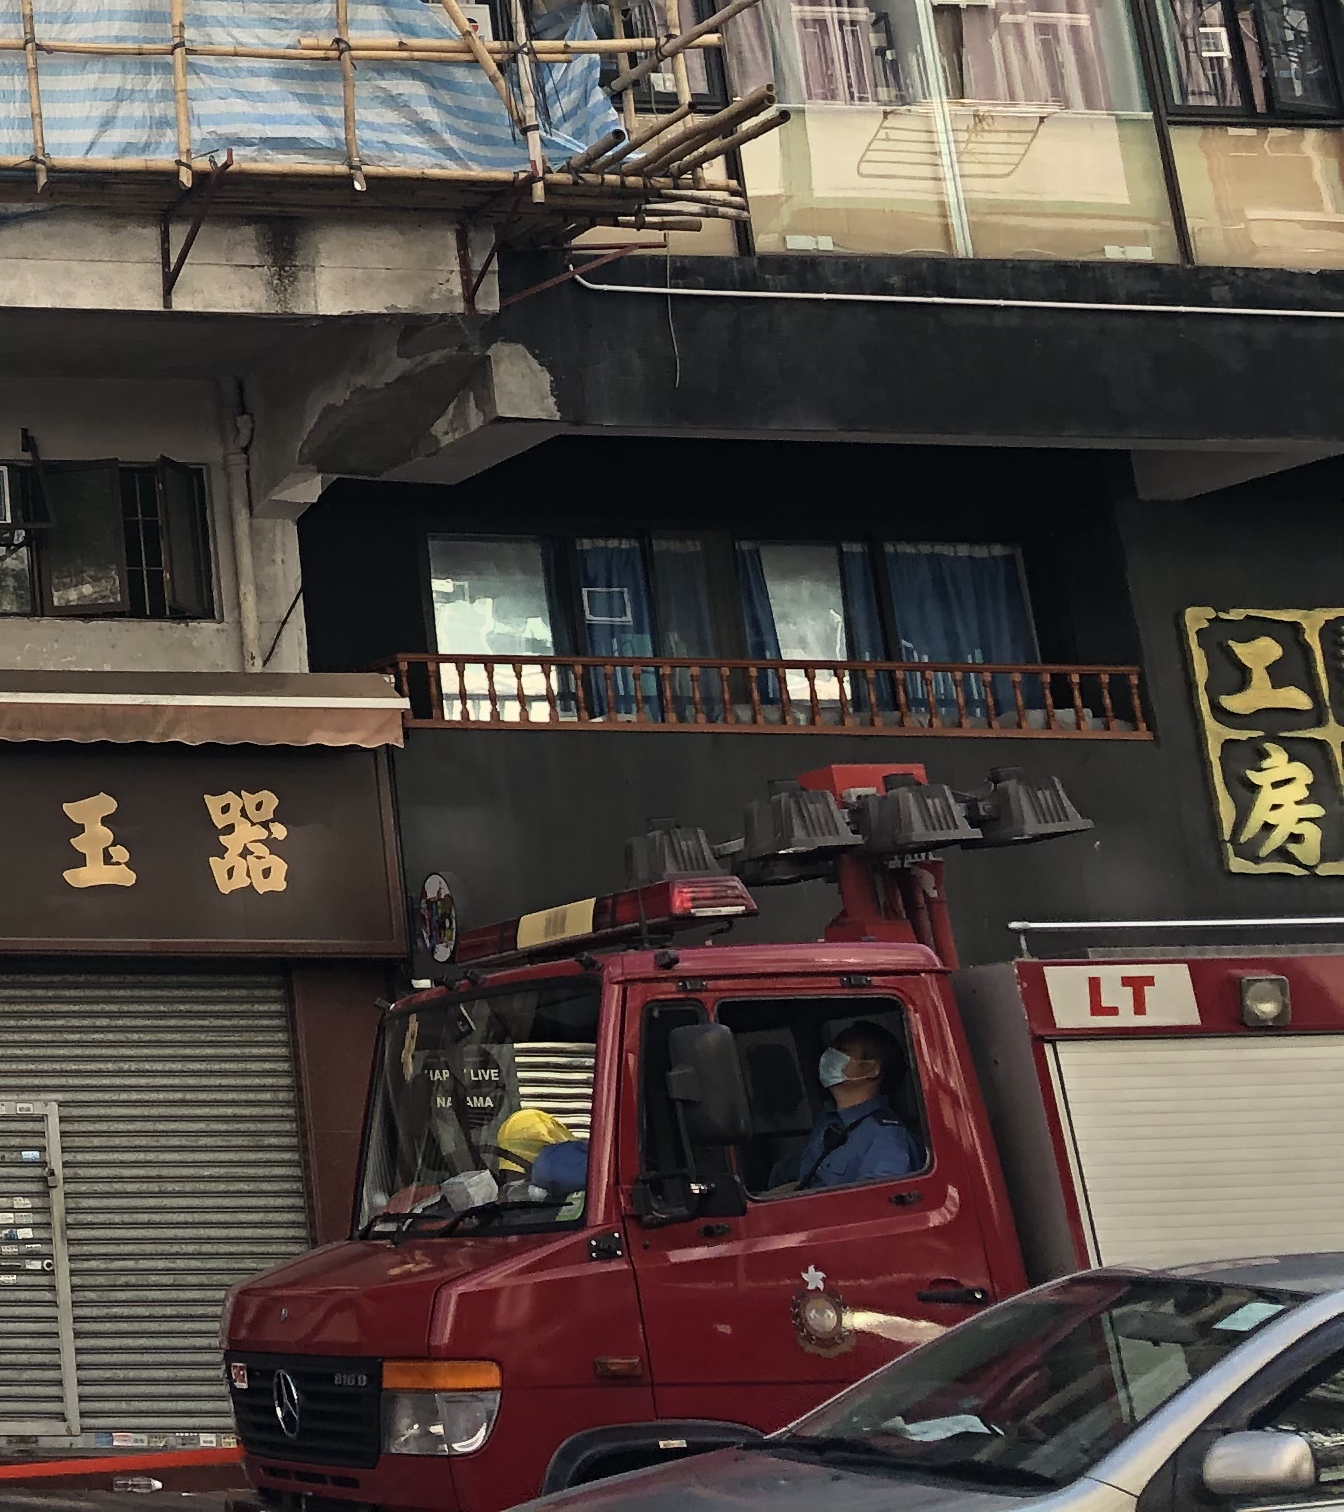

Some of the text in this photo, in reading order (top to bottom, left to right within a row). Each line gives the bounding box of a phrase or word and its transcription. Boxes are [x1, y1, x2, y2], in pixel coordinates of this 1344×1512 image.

[1218, 636, 1326, 866] 工房
[1088, 975, 1156, 1017] LT
[470, 1069, 500, 1081] LIVE
[436, 1096, 494, 1108] NAAMA
